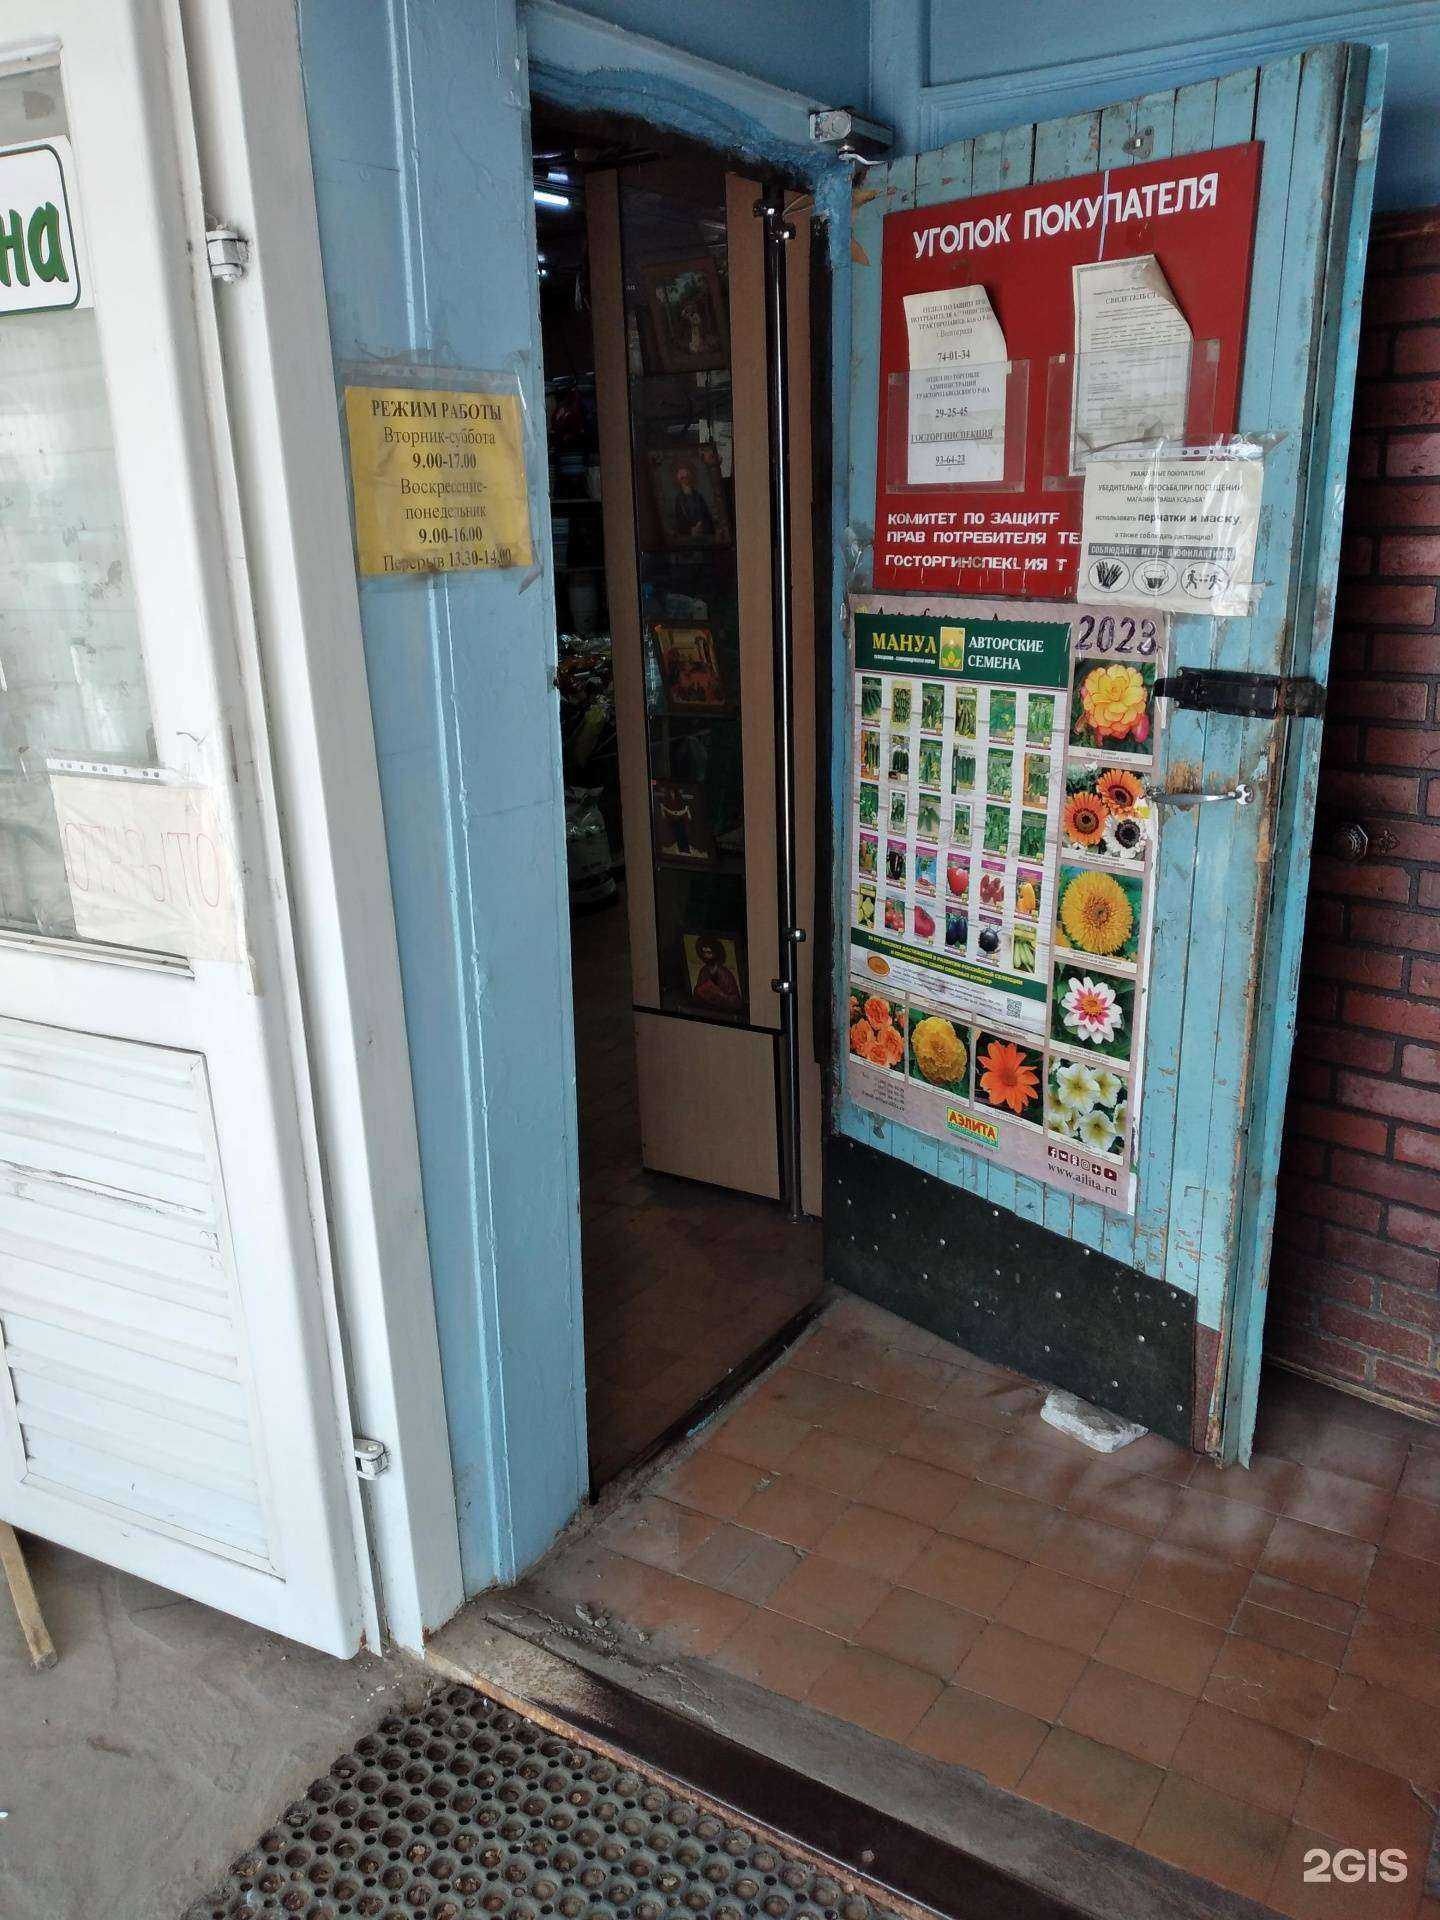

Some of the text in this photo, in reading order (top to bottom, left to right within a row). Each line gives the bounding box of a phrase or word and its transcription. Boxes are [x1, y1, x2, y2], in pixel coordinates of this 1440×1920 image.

[913, 172, 1218, 259] УГОЛОК ПОКУПАТЕЛЯ
[937, 350, 970, 361] 74-01-34
[372, 400, 502, 421] РЕЖИМ РАБОТЫ
[383, 426, 496, 448] Вторник-суббота
[412, 453, 477, 469] 9.00-17.00
[887, 512, 957, 525] КОМИТЕТ
[963, 512, 985, 525] ПО
[418, 527, 482, 544] 9.00-16.00
[887, 531, 1082, 545] ПРАВ ПОТРЕБИТЕЛЯ ТЕ
[872, 632, 1045, 654] МАНУЛ АВТОРСКИЕ
[968, 655, 1021, 671] СЕМЕНА
[949, 1111, 996, 1139] АЭЛИТА
[1048, 1162, 1117, 1197] www.ailita.ru
